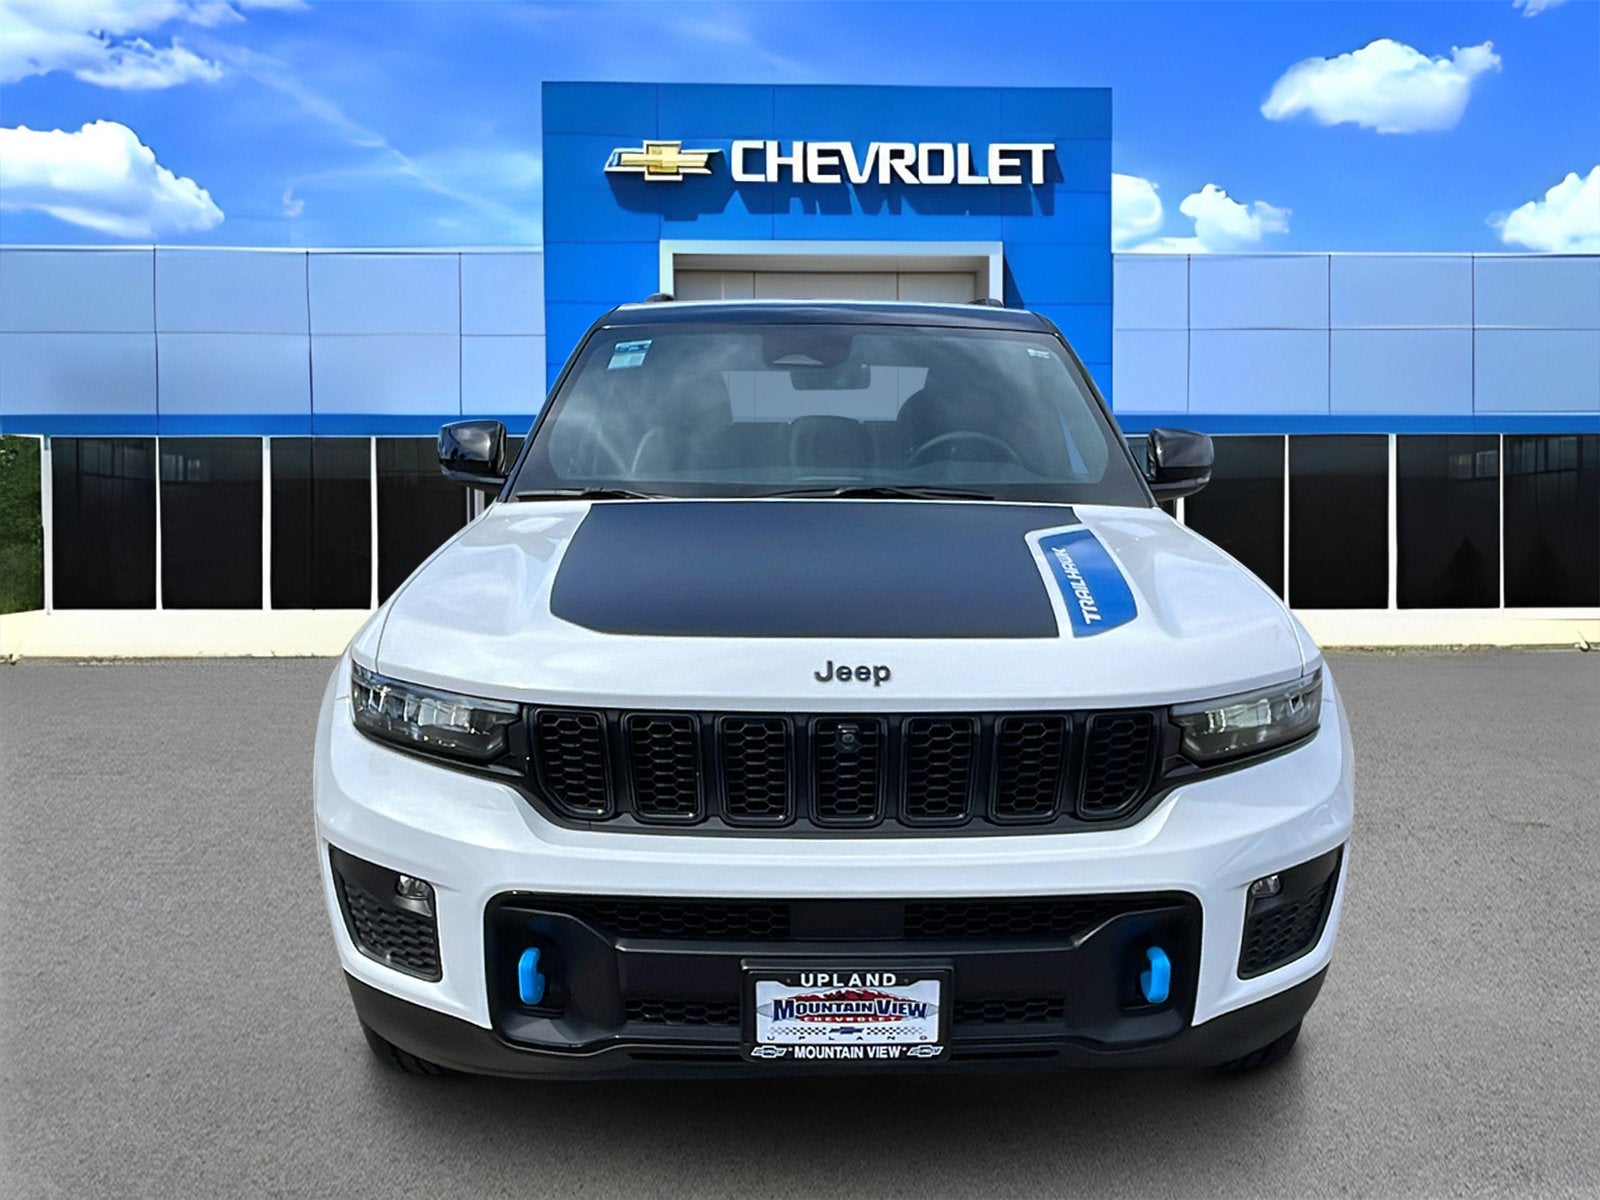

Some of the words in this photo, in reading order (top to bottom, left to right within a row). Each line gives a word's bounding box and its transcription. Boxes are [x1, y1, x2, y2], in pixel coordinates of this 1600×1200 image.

[731, 140, 1055, 185] CHEVROLET
[813, 660, 891, 687] Jeep
[801, 973, 896, 987] UPLAND
[773, 999, 872, 1020] MOUNTAIN
[876, 999, 927, 1018] VIEW
[794, 1046, 864, 1059] MOUNTAIN
[868, 1046, 901, 1059] VIEW
